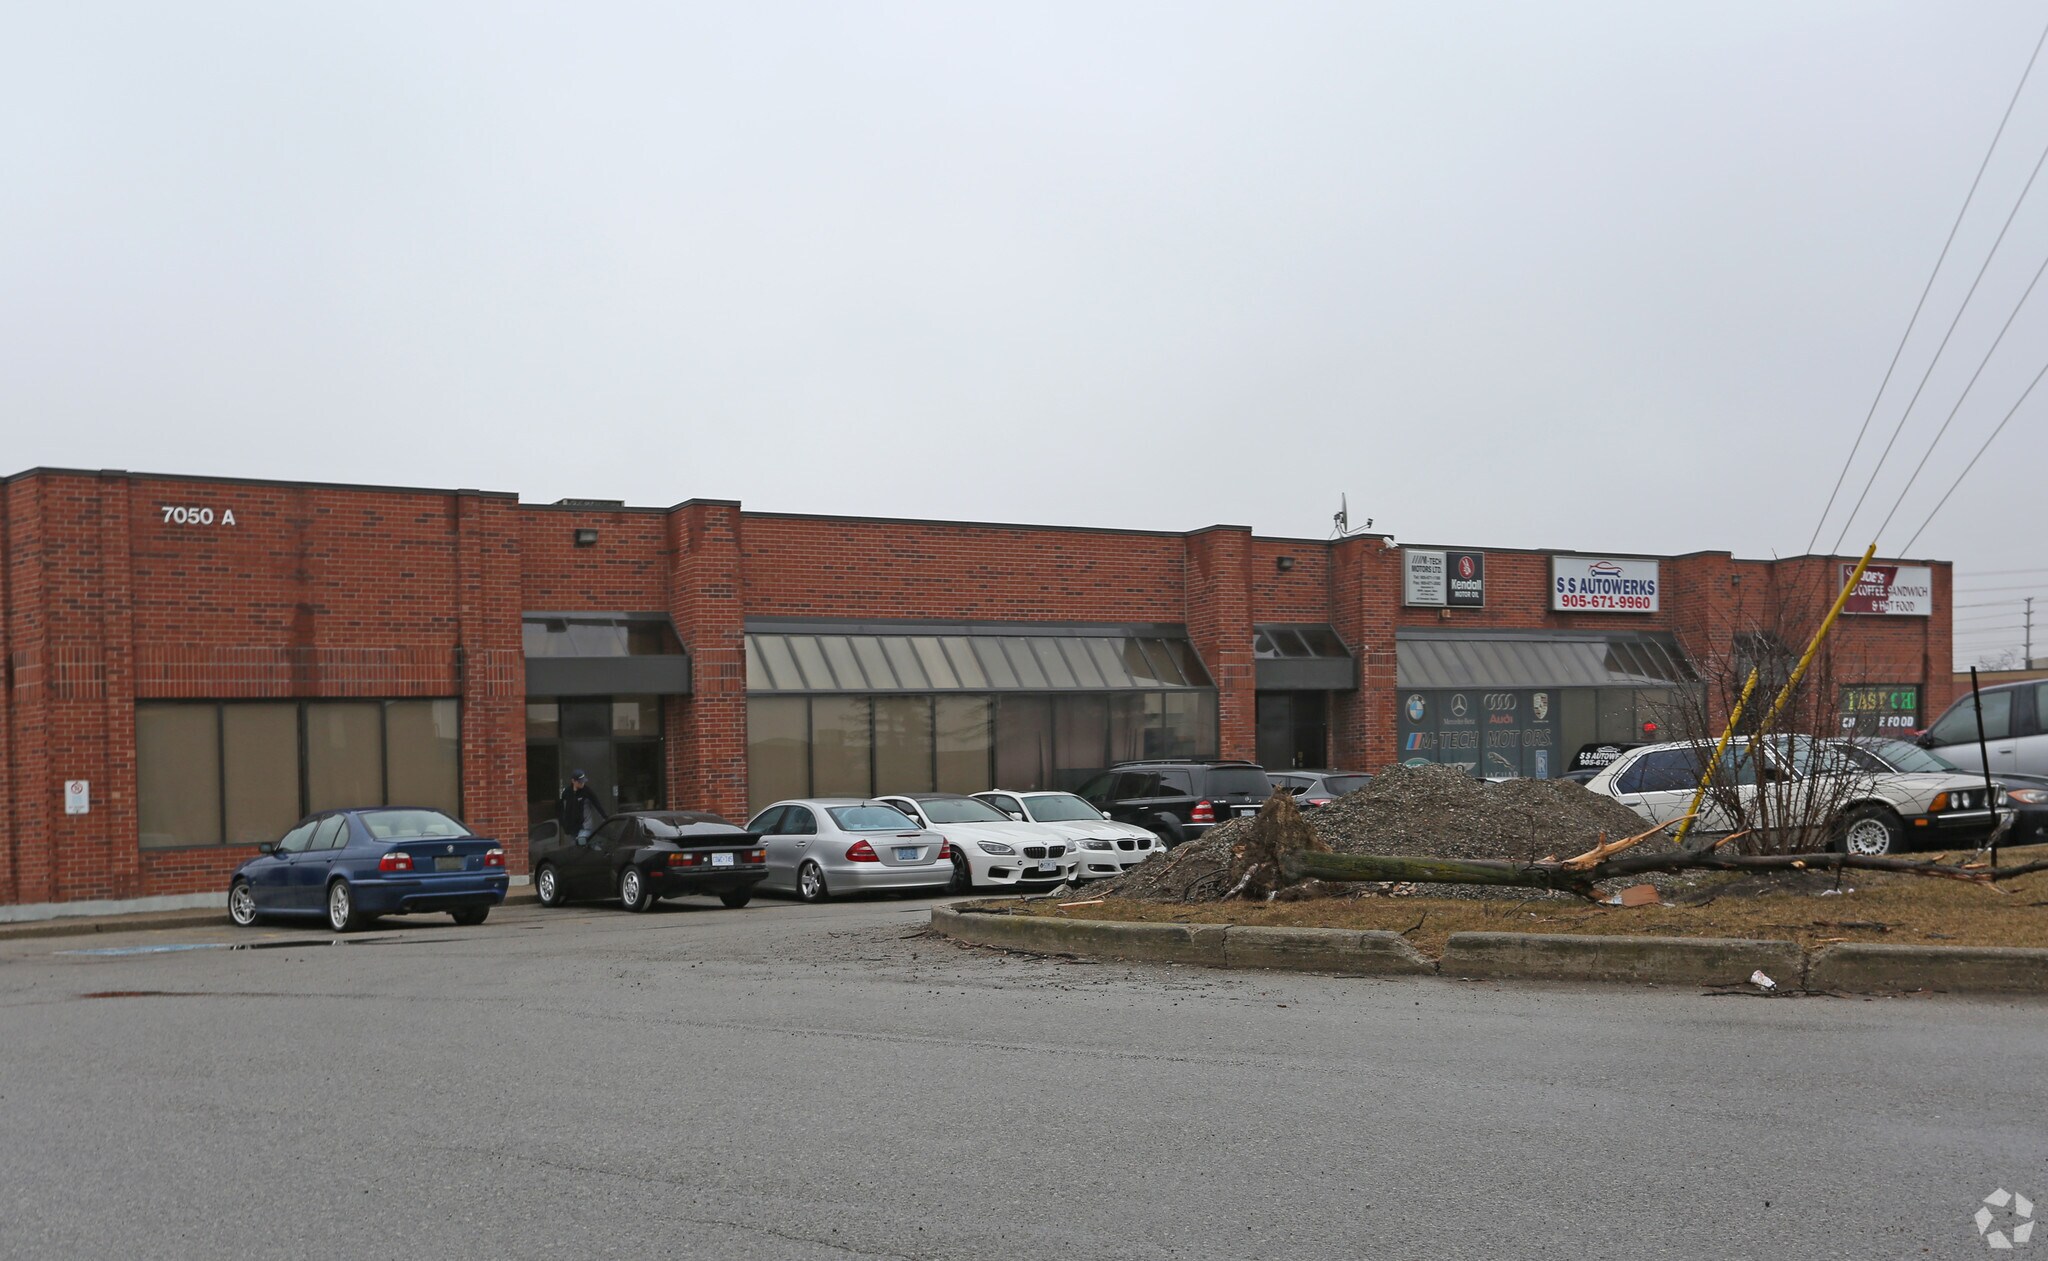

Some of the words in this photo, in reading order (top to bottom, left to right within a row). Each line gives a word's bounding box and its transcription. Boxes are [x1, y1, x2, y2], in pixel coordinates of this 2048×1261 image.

[161, 506, 214, 525] 7050
[221, 509, 236, 526] A
[1411, 565, 1431, 573] MOTORS
[1860, 570, 1885, 584] JOE'S
[1451, 578, 1482, 590] Kendall
[1557, 577, 1565, 593] S
[1568, 577, 1576, 594] S
[1579, 578, 1655, 595] AUTOWERKS
[1454, 590, 1471, 598] MOTOR
[1887, 585, 1928, 597] SANDWICH
[1562, 594, 1650, 609] 905-671-9960
[1872, 600, 1879, 611] &
[1879, 601, 1894, 612] HOT
[1896, 601, 1915, 612] FOOD
[1489, 714, 1513, 724] Audi
[1887, 716, 1914, 727] FOOD
